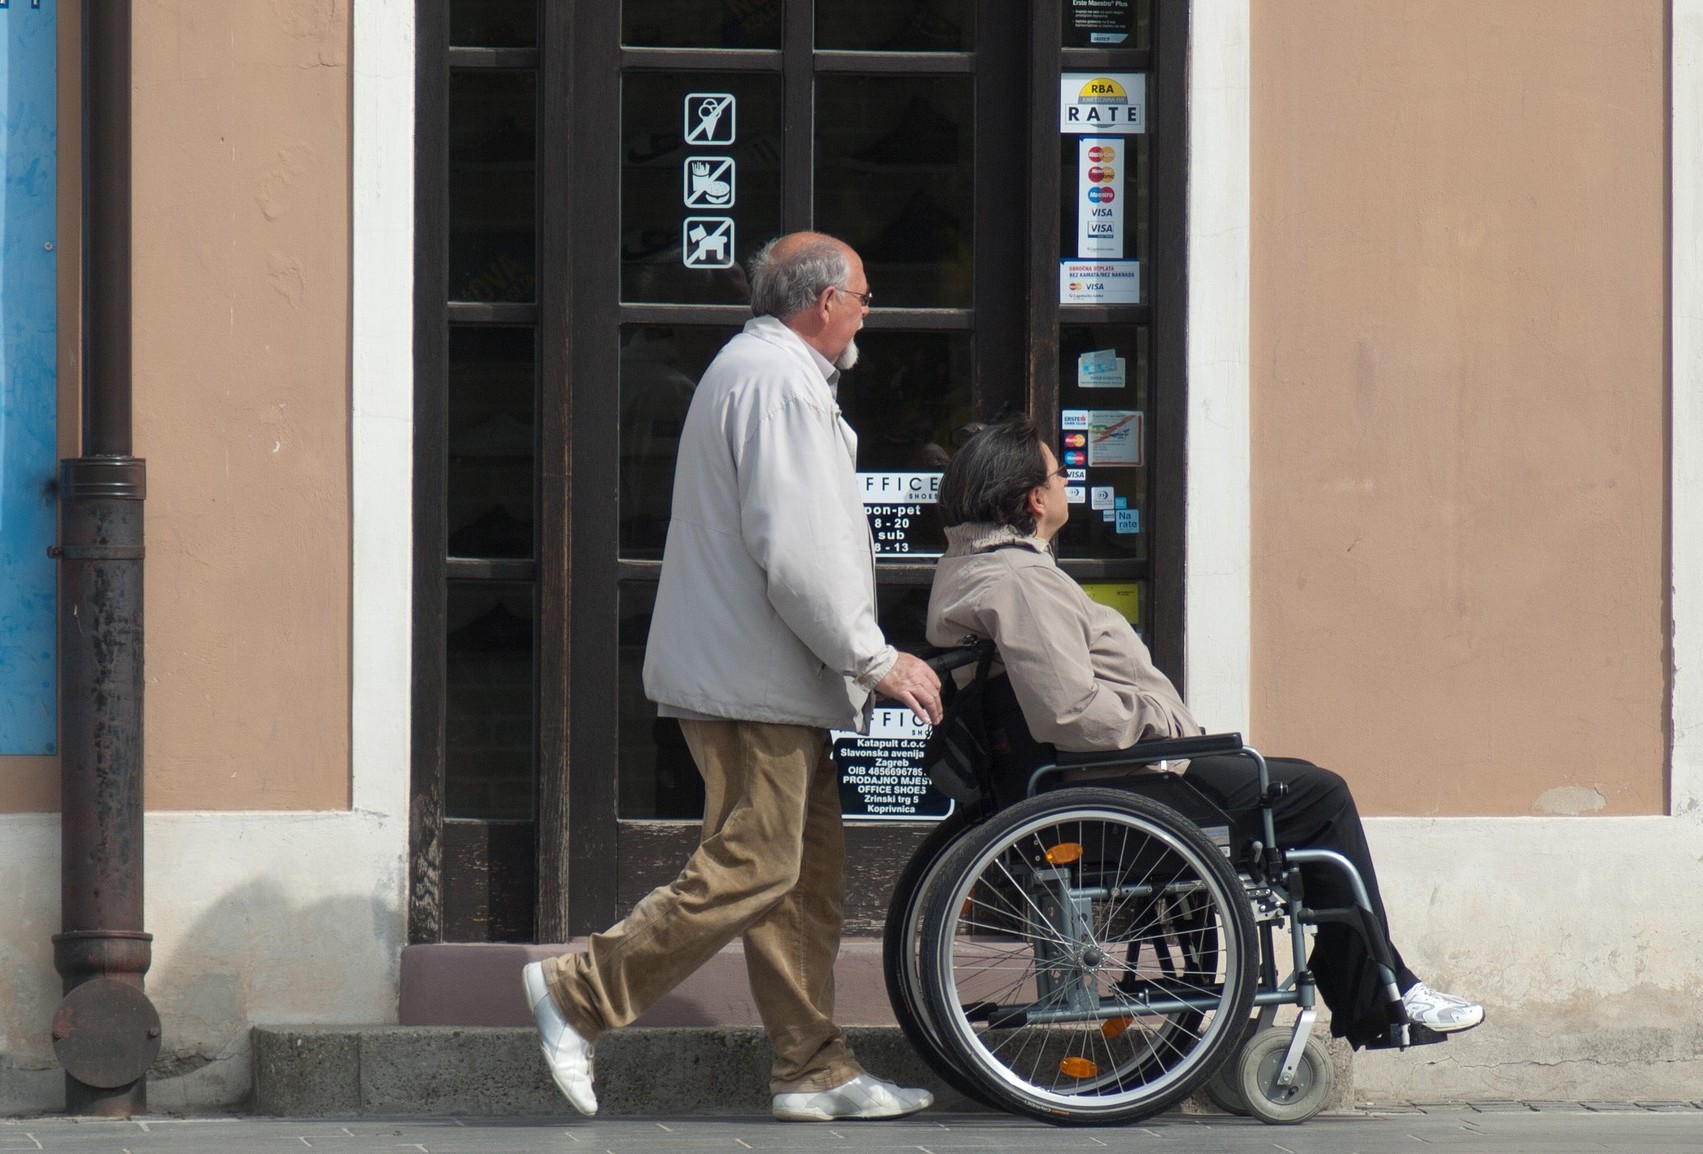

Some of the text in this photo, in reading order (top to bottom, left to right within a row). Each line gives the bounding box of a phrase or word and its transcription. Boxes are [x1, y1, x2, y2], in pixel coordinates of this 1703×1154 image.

[1091, 84, 1114, 94] RBA
[1068, 106, 1137, 122] RATE
[1091, 208, 1113, 217] VISA
[1091, 224, 1113, 233] VISA
[1067, 471, 1085, 479] VISA
[866, 477, 938, 491] FFICE
[864, 505, 921, 517] pon-pet
[1118, 511, 1132, 520] Na
[874, 518, 882, 529] 8
[894, 518, 910, 529] 20
[1119, 521, 1138, 529] rate
[878, 530, 905, 540] sub
[874, 542, 881, 552] 8
[894, 542, 909, 552] 13
[857, 739, 899, 749] Katapult
[840, 748, 925, 759] Slavonska avenija
[875, 758, 909, 768] Zagreb
[848, 766, 866, 775] OIB
[843, 776, 898, 785] PRODAJNO
[857, 785, 927, 795] OFFICE SHOES
[864, 794, 919, 805] Zrinski trg 5
[867, 804, 915, 814] Koprivnica
